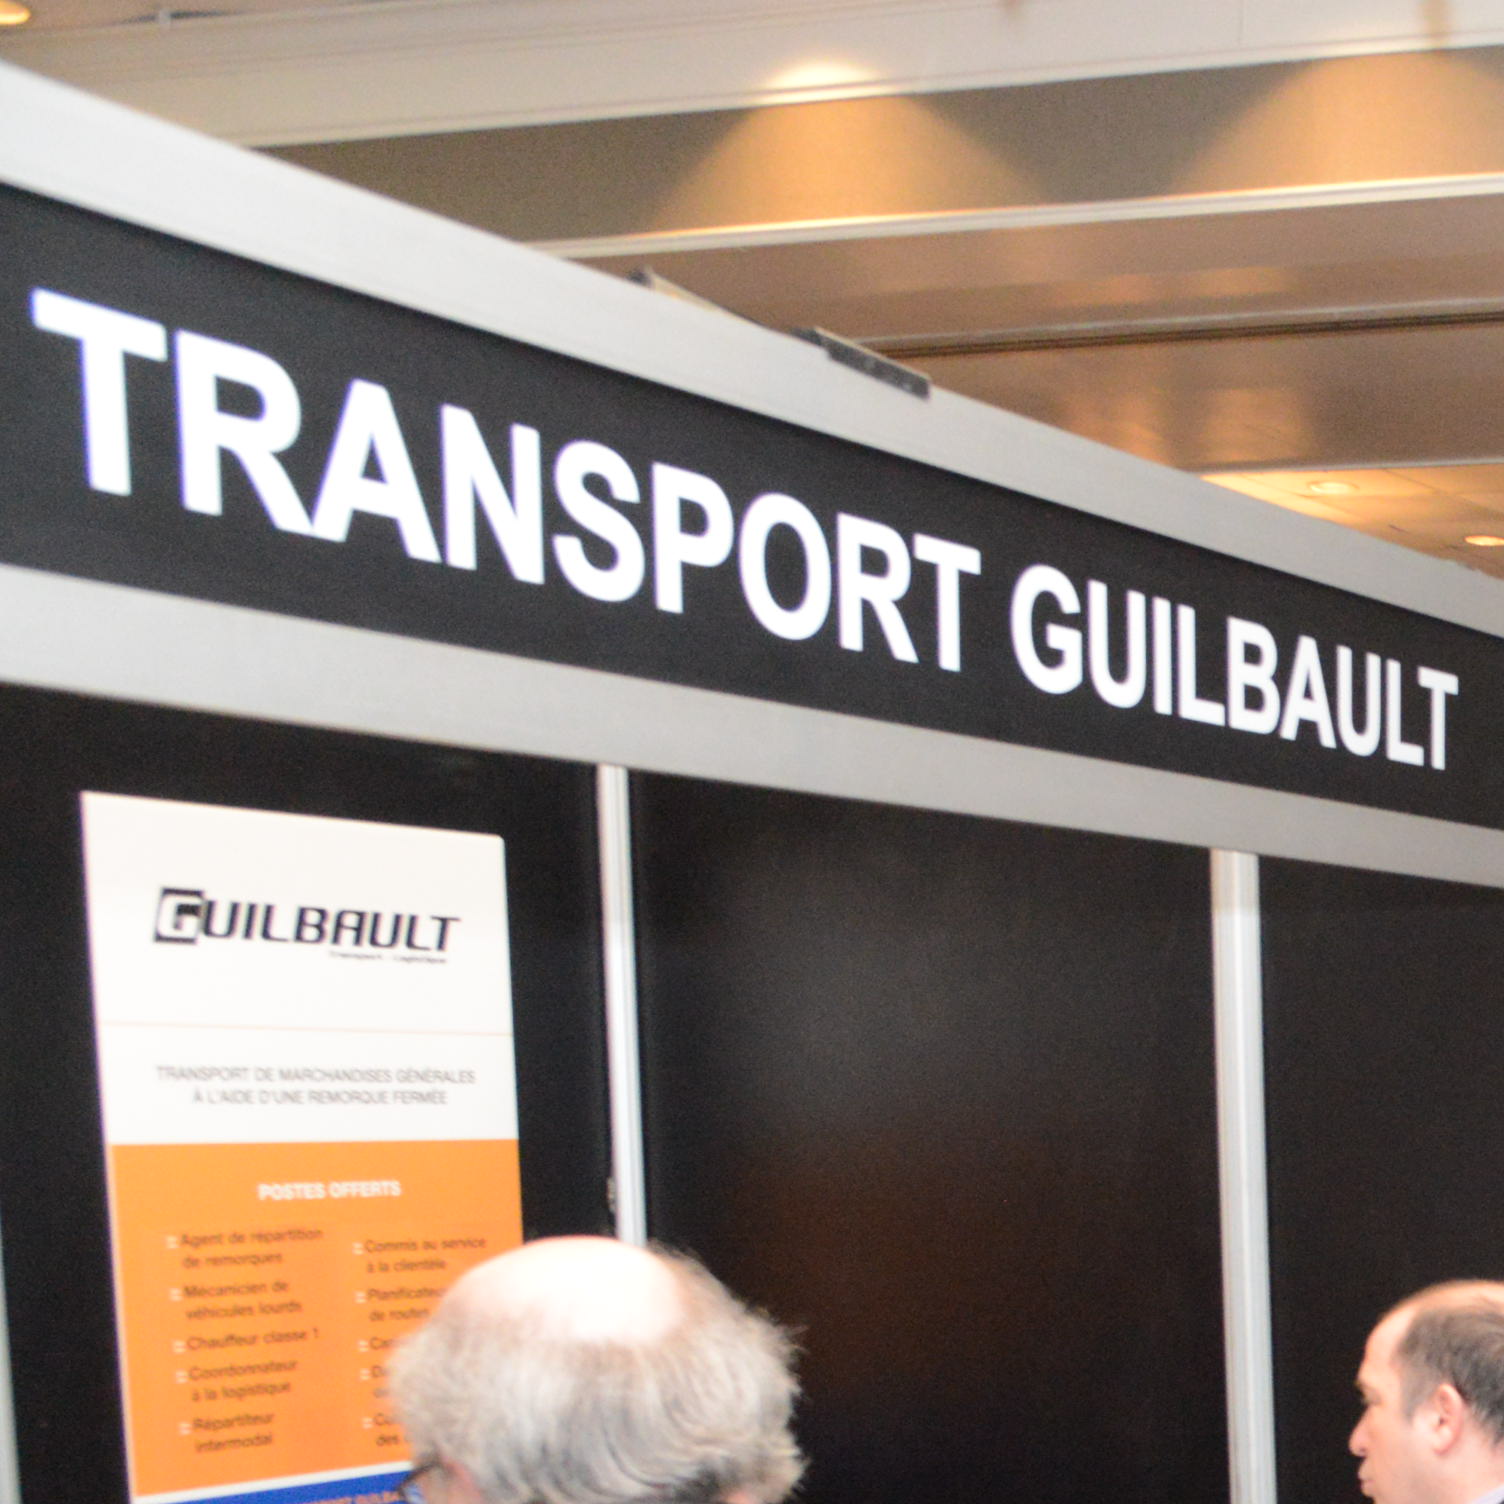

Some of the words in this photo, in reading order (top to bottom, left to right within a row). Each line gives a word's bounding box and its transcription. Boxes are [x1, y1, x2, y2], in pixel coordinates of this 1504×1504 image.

[29, 287, 982, 672] TRANSPORT
[1010, 563, 1460, 770] GUILBAULT
[153, 886, 461, 952] GUILBAULT
[157, 1065, 249, 1083] TRANSPORT
[254, 1066, 274, 1083] DE
[279, 1067, 393, 1084] MARCHANDISES
[396, 1066, 477, 1085] GÉNÉRALES
[308, 1089, 390, 1105] REMORQUE
[256, 1181, 326, 1201] POSTES
[328, 1180, 402, 1199] OFFERTS
[180, 1232, 223, 1249] Agent
[228, 1231, 245, 1245] de
[364, 1239, 417, 1253] Commis
[441, 1238, 486, 1250] service
[271, 1280, 288, 1293] de
